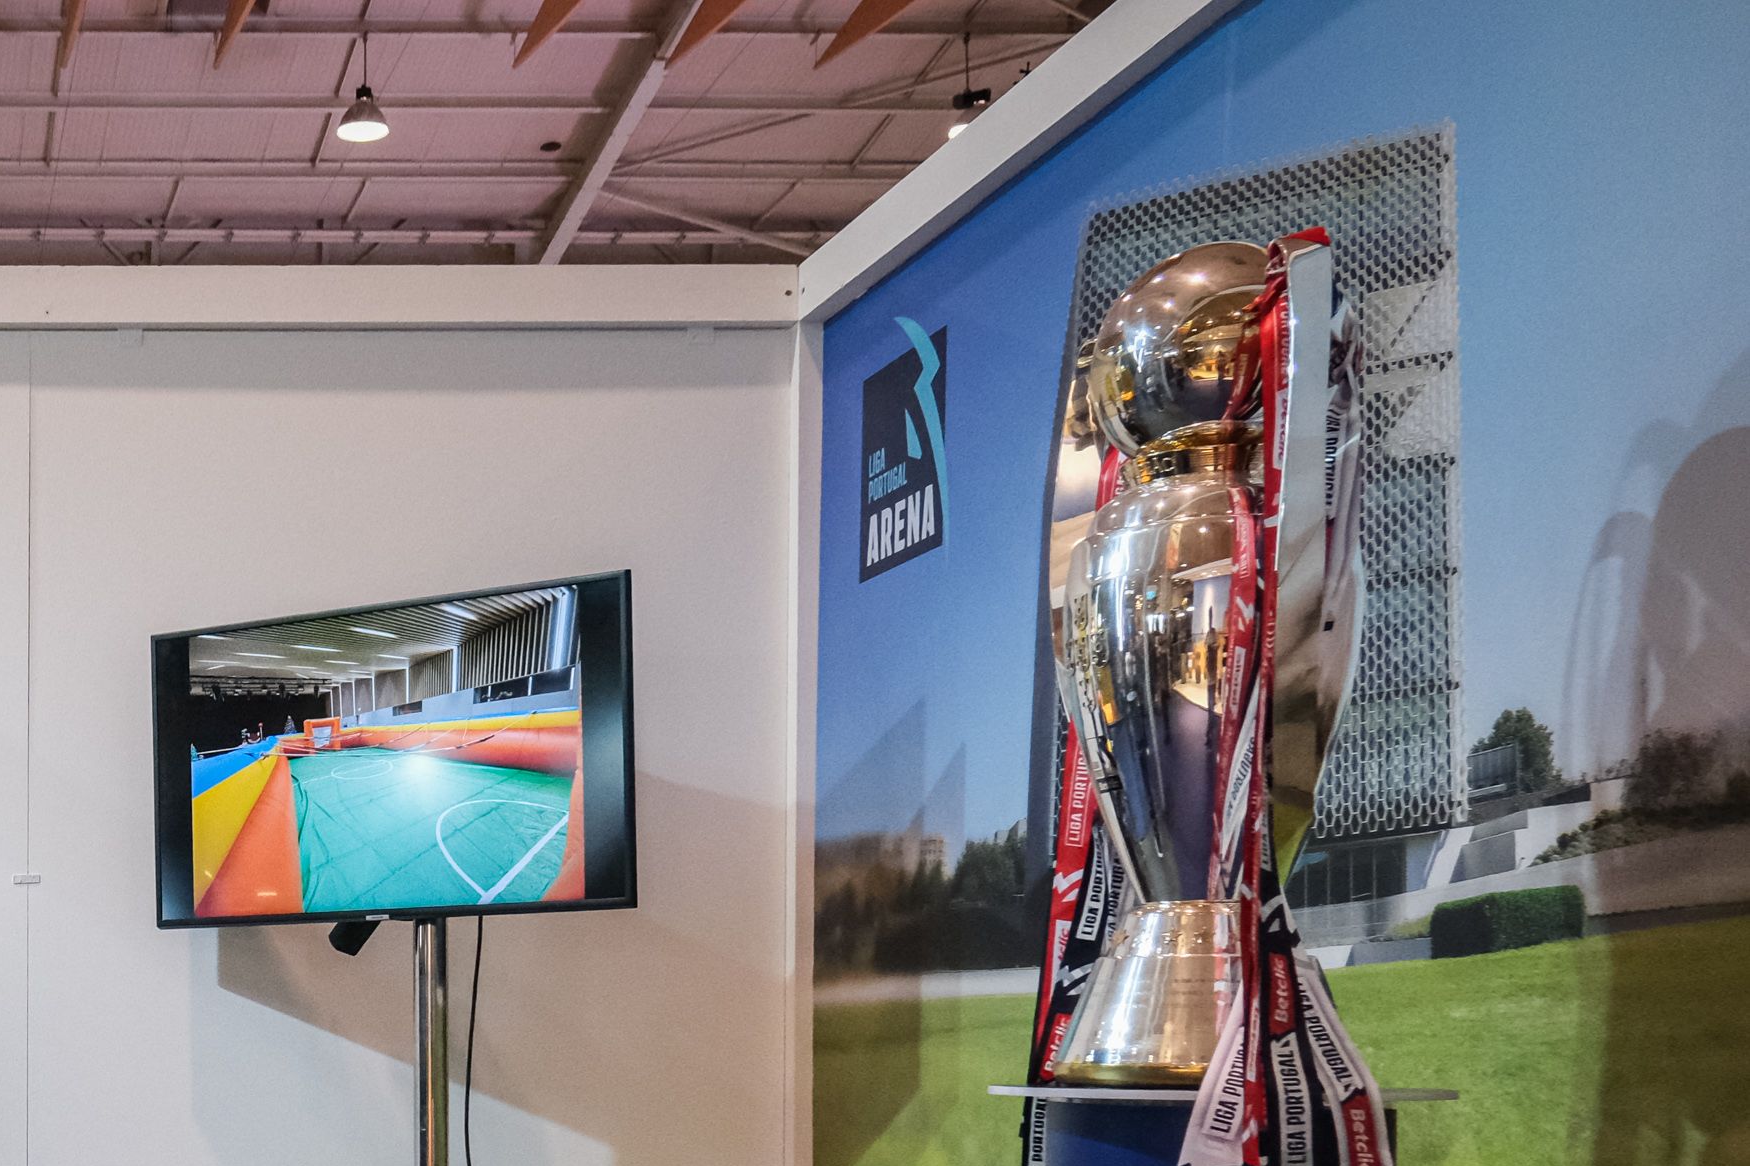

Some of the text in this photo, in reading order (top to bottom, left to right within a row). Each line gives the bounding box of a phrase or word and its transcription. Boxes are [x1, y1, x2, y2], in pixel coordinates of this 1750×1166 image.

[869, 447, 886, 478] LIGA
[869, 461, 907, 504] PORTUGAL
[866, 484, 935, 567] ARENA
[1068, 811, 1083, 842] LIGA
[1081, 908, 1099, 936] LIGA
[1274, 957, 1290, 1024] Betclic
[1303, 1015, 1354, 1084] PORTUGAL
[1210, 1106, 1239, 1133] LIGA
[1277, 1050, 1307, 1165] LIGA PORTUGAL
